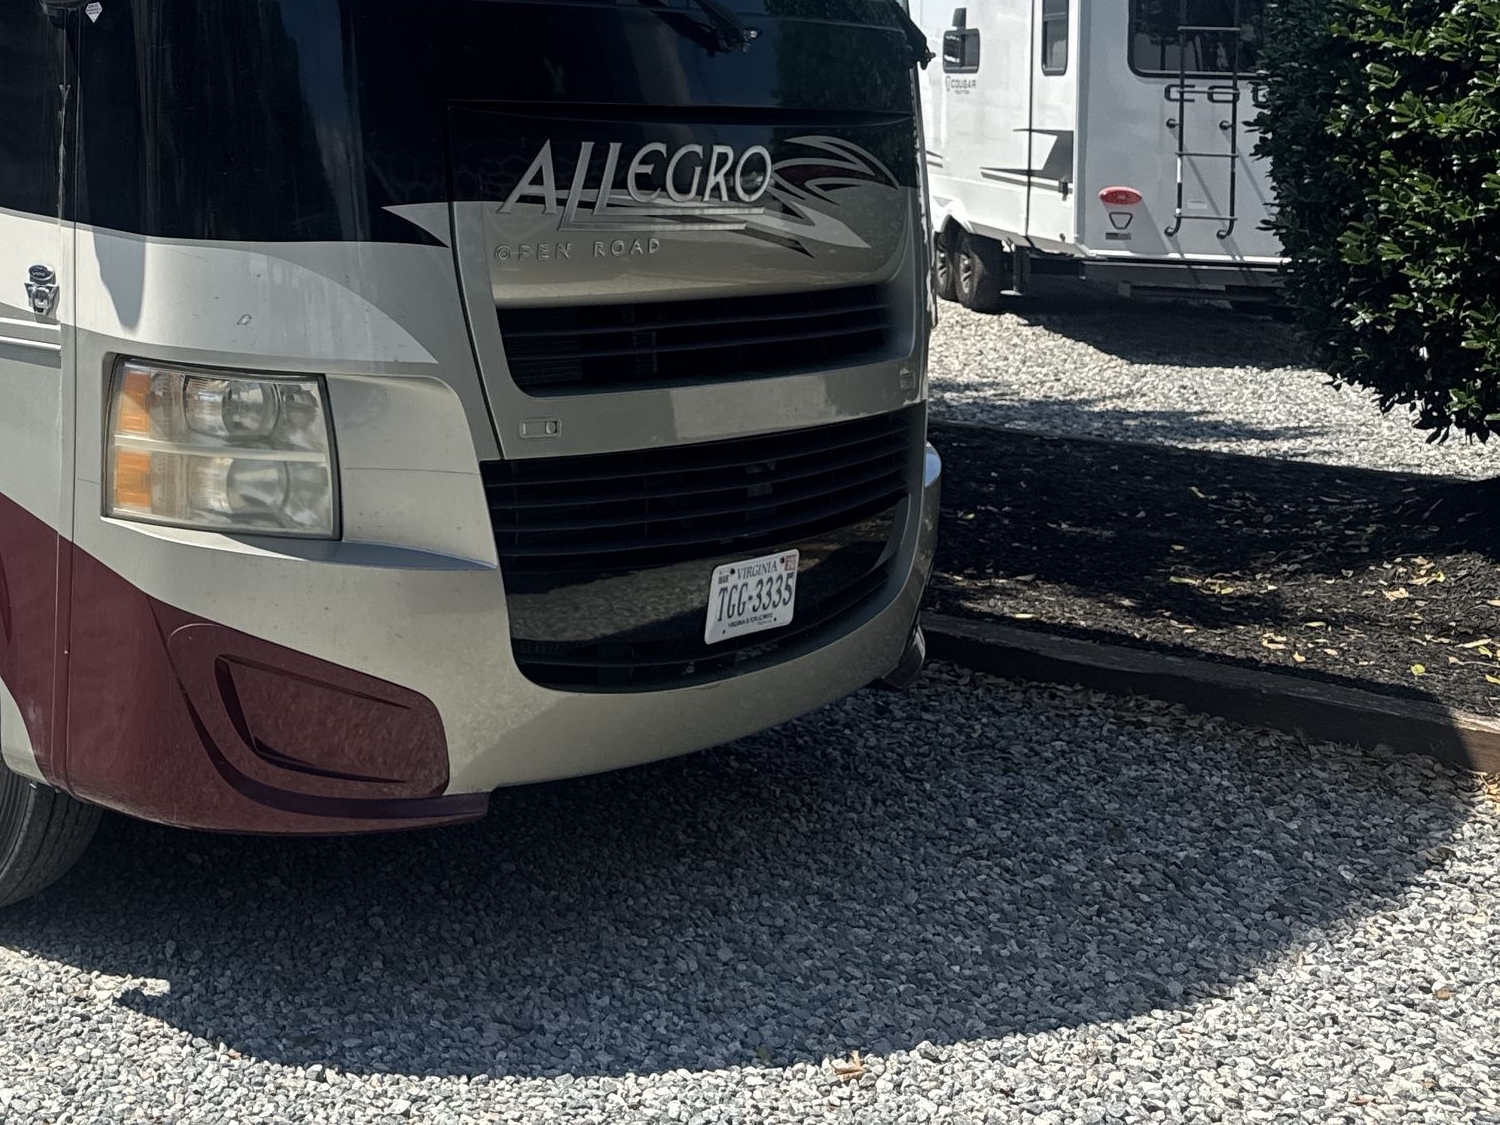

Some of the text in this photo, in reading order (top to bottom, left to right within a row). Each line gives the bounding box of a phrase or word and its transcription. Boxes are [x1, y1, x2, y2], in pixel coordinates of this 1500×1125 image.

[495, 138, 772, 232] ALLEGRO
[494, 238, 661, 261] OPEN ROAD
[737, 560, 778, 580] VIRGINIA
[717, 572, 795, 622] TGG-3335
